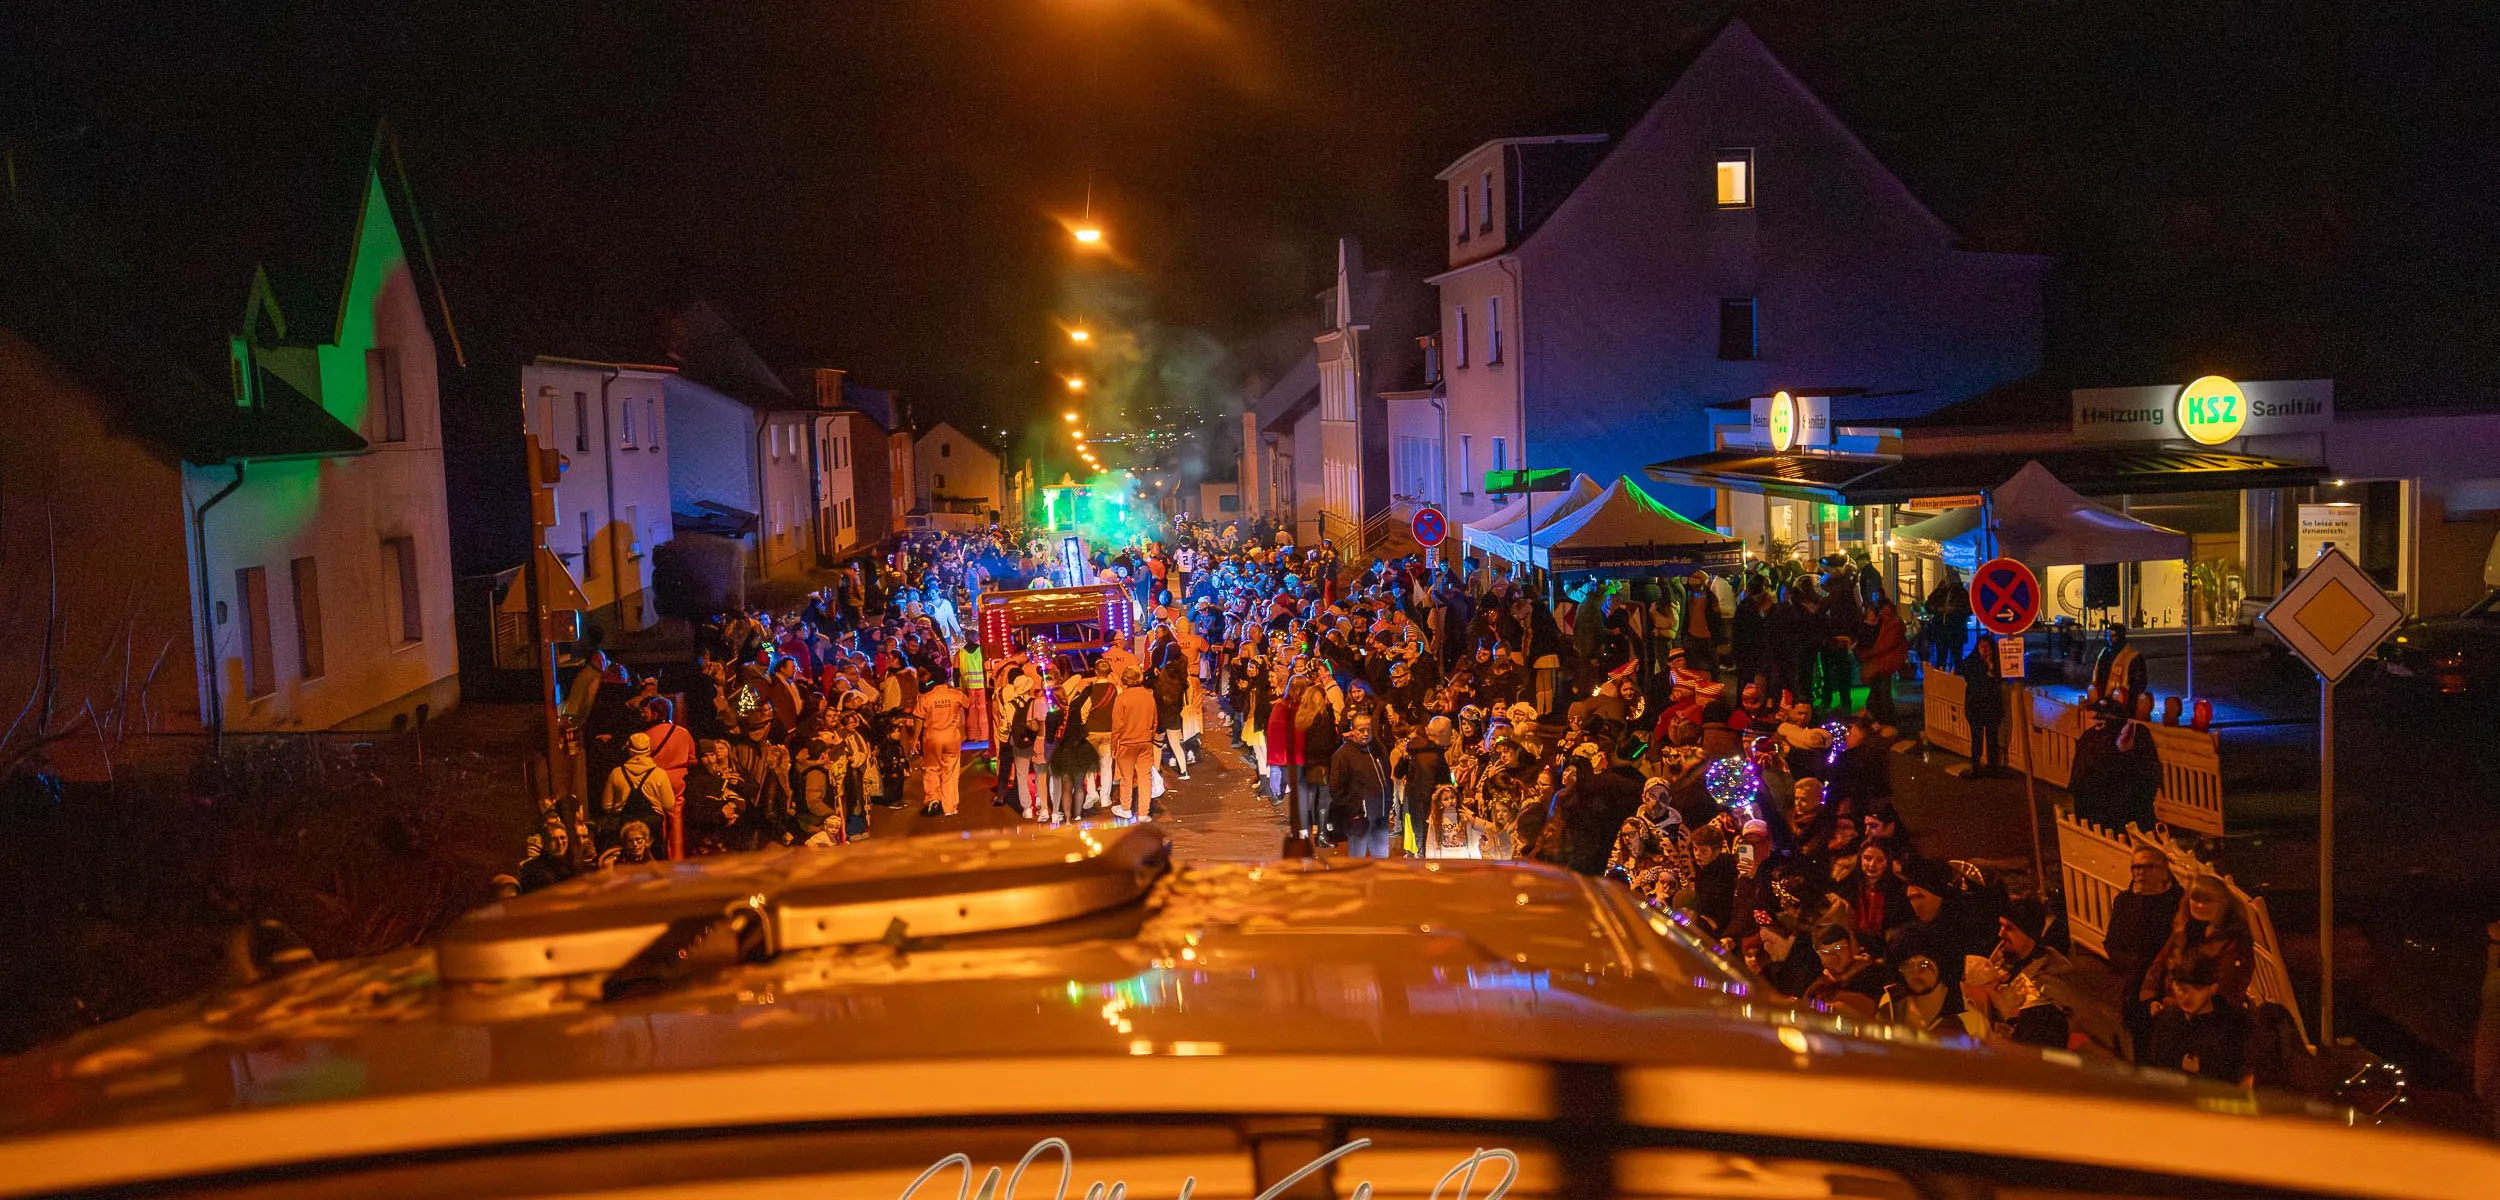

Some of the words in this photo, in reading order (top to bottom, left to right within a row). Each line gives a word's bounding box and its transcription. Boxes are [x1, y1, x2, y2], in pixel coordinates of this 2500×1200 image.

[2082, 405, 2164, 425] Heizung
[2188, 396, 2237, 425] KSZ
[2252, 398, 2322, 417] Sanitär
